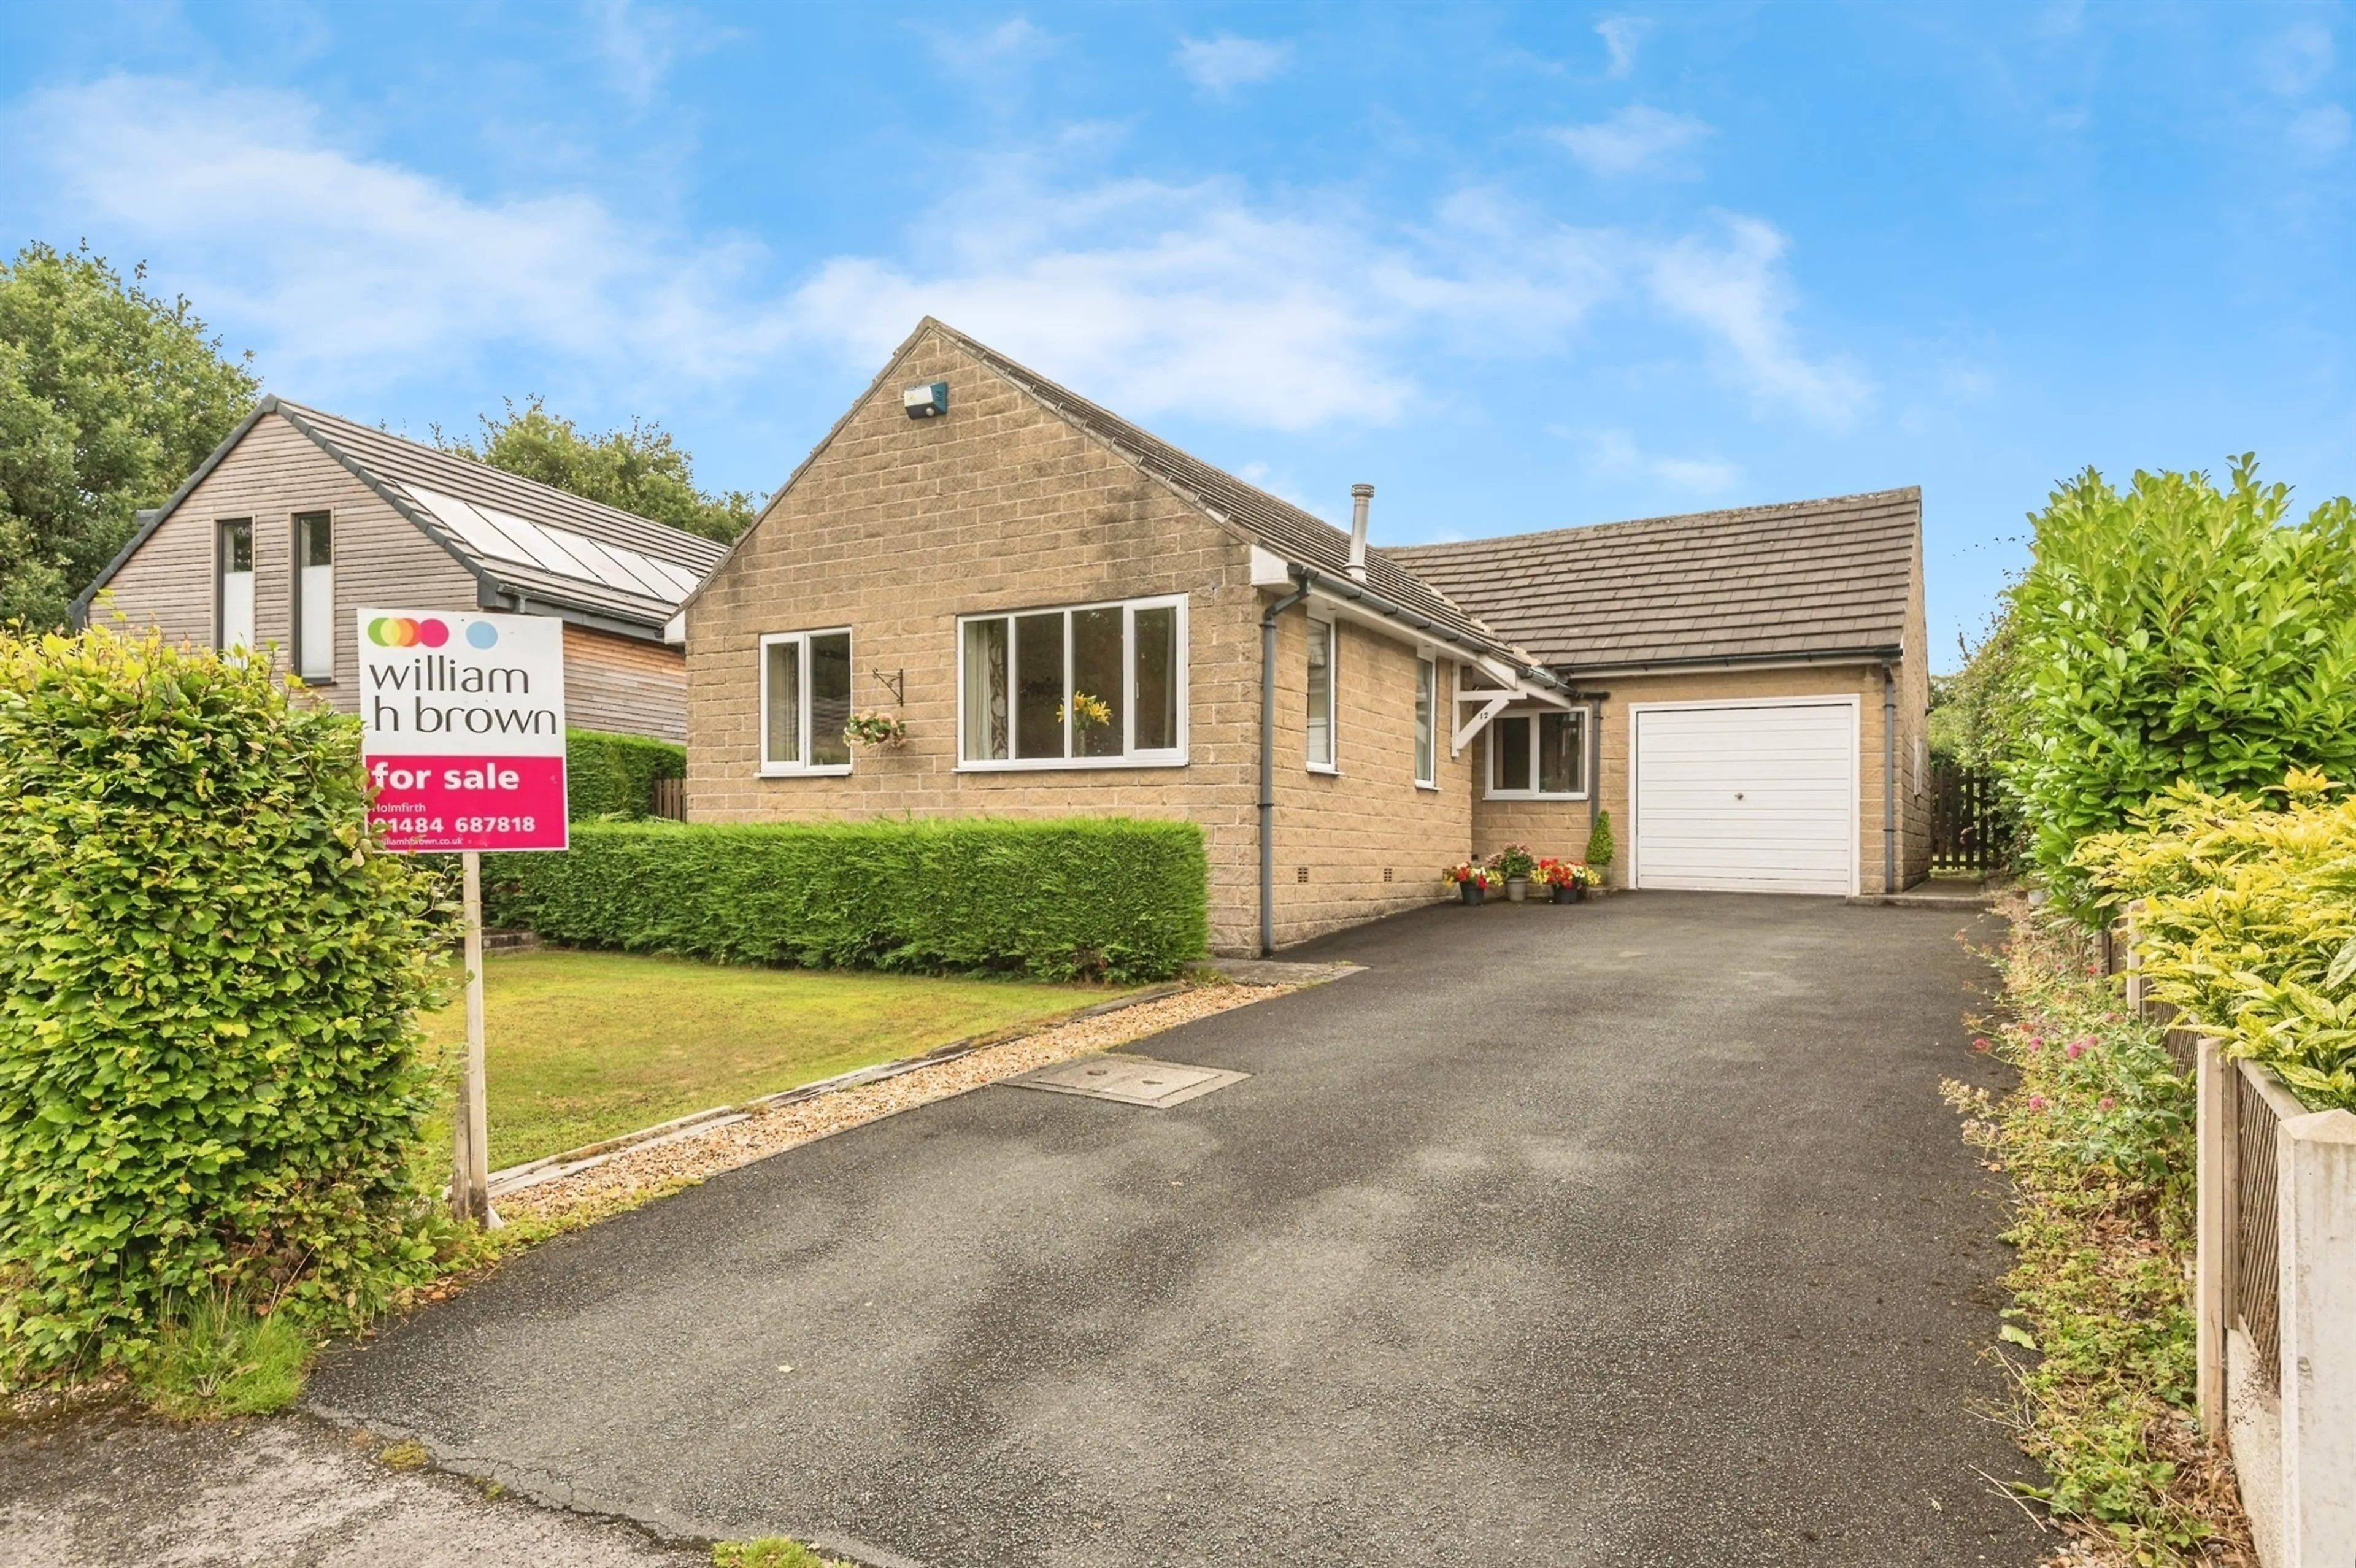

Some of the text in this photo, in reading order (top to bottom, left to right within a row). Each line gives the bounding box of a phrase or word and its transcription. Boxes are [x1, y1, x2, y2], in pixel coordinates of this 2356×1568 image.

[369, 655, 528, 693] william
[375, 696, 556, 734] h brown
[371, 762, 519, 790] for sale
[455, 817, 535, 832] 687818
